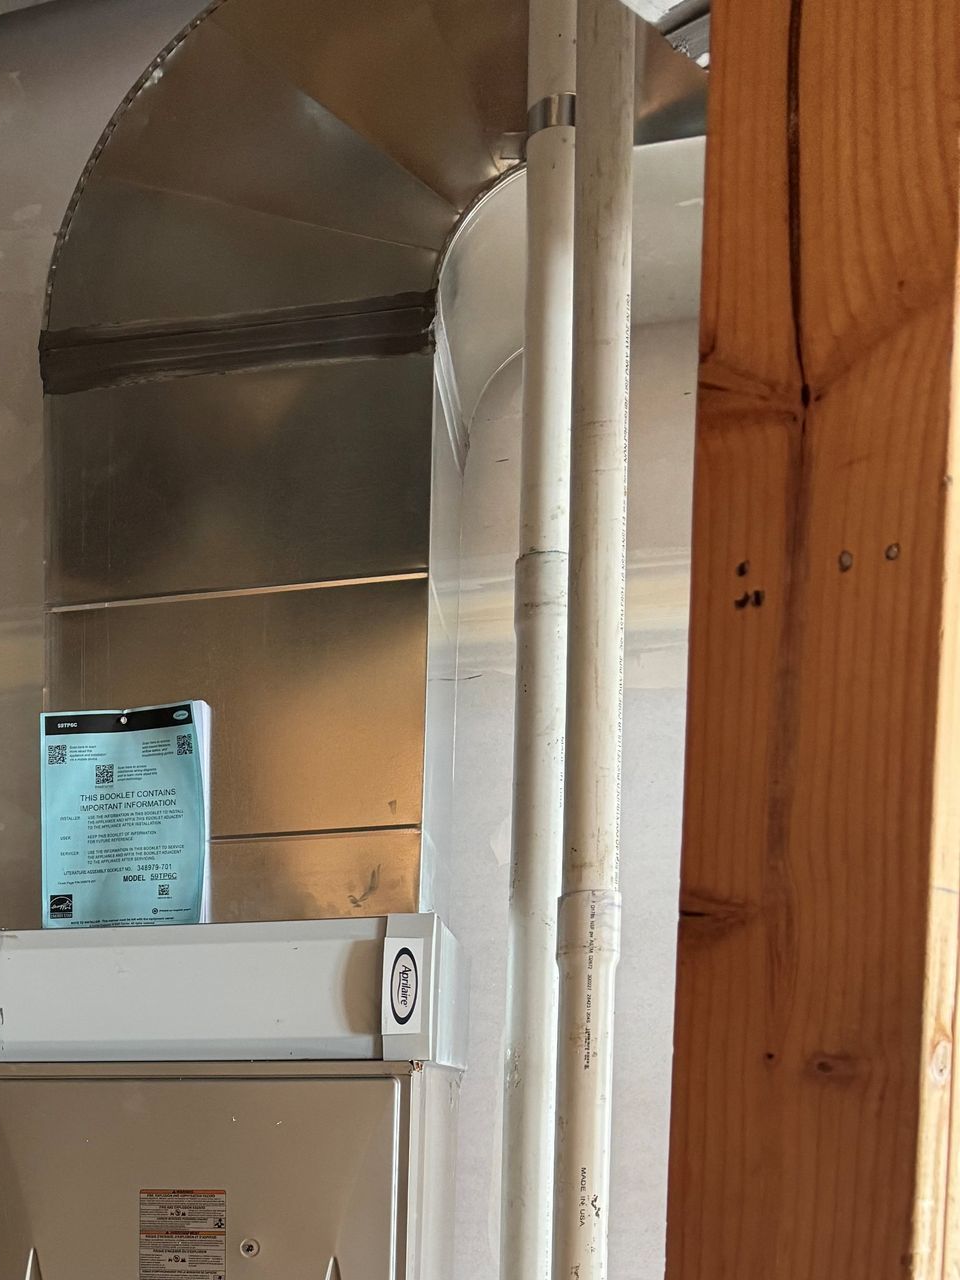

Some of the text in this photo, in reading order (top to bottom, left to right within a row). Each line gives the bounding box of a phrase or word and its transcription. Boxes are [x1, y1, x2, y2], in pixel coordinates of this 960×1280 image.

[80, 788, 176, 802] THIS BOOKLET CONTAINS
[80, 799, 176, 812] IMPORTANT INFORMATION
[397, 964, 412, 1007] Aprilaire
